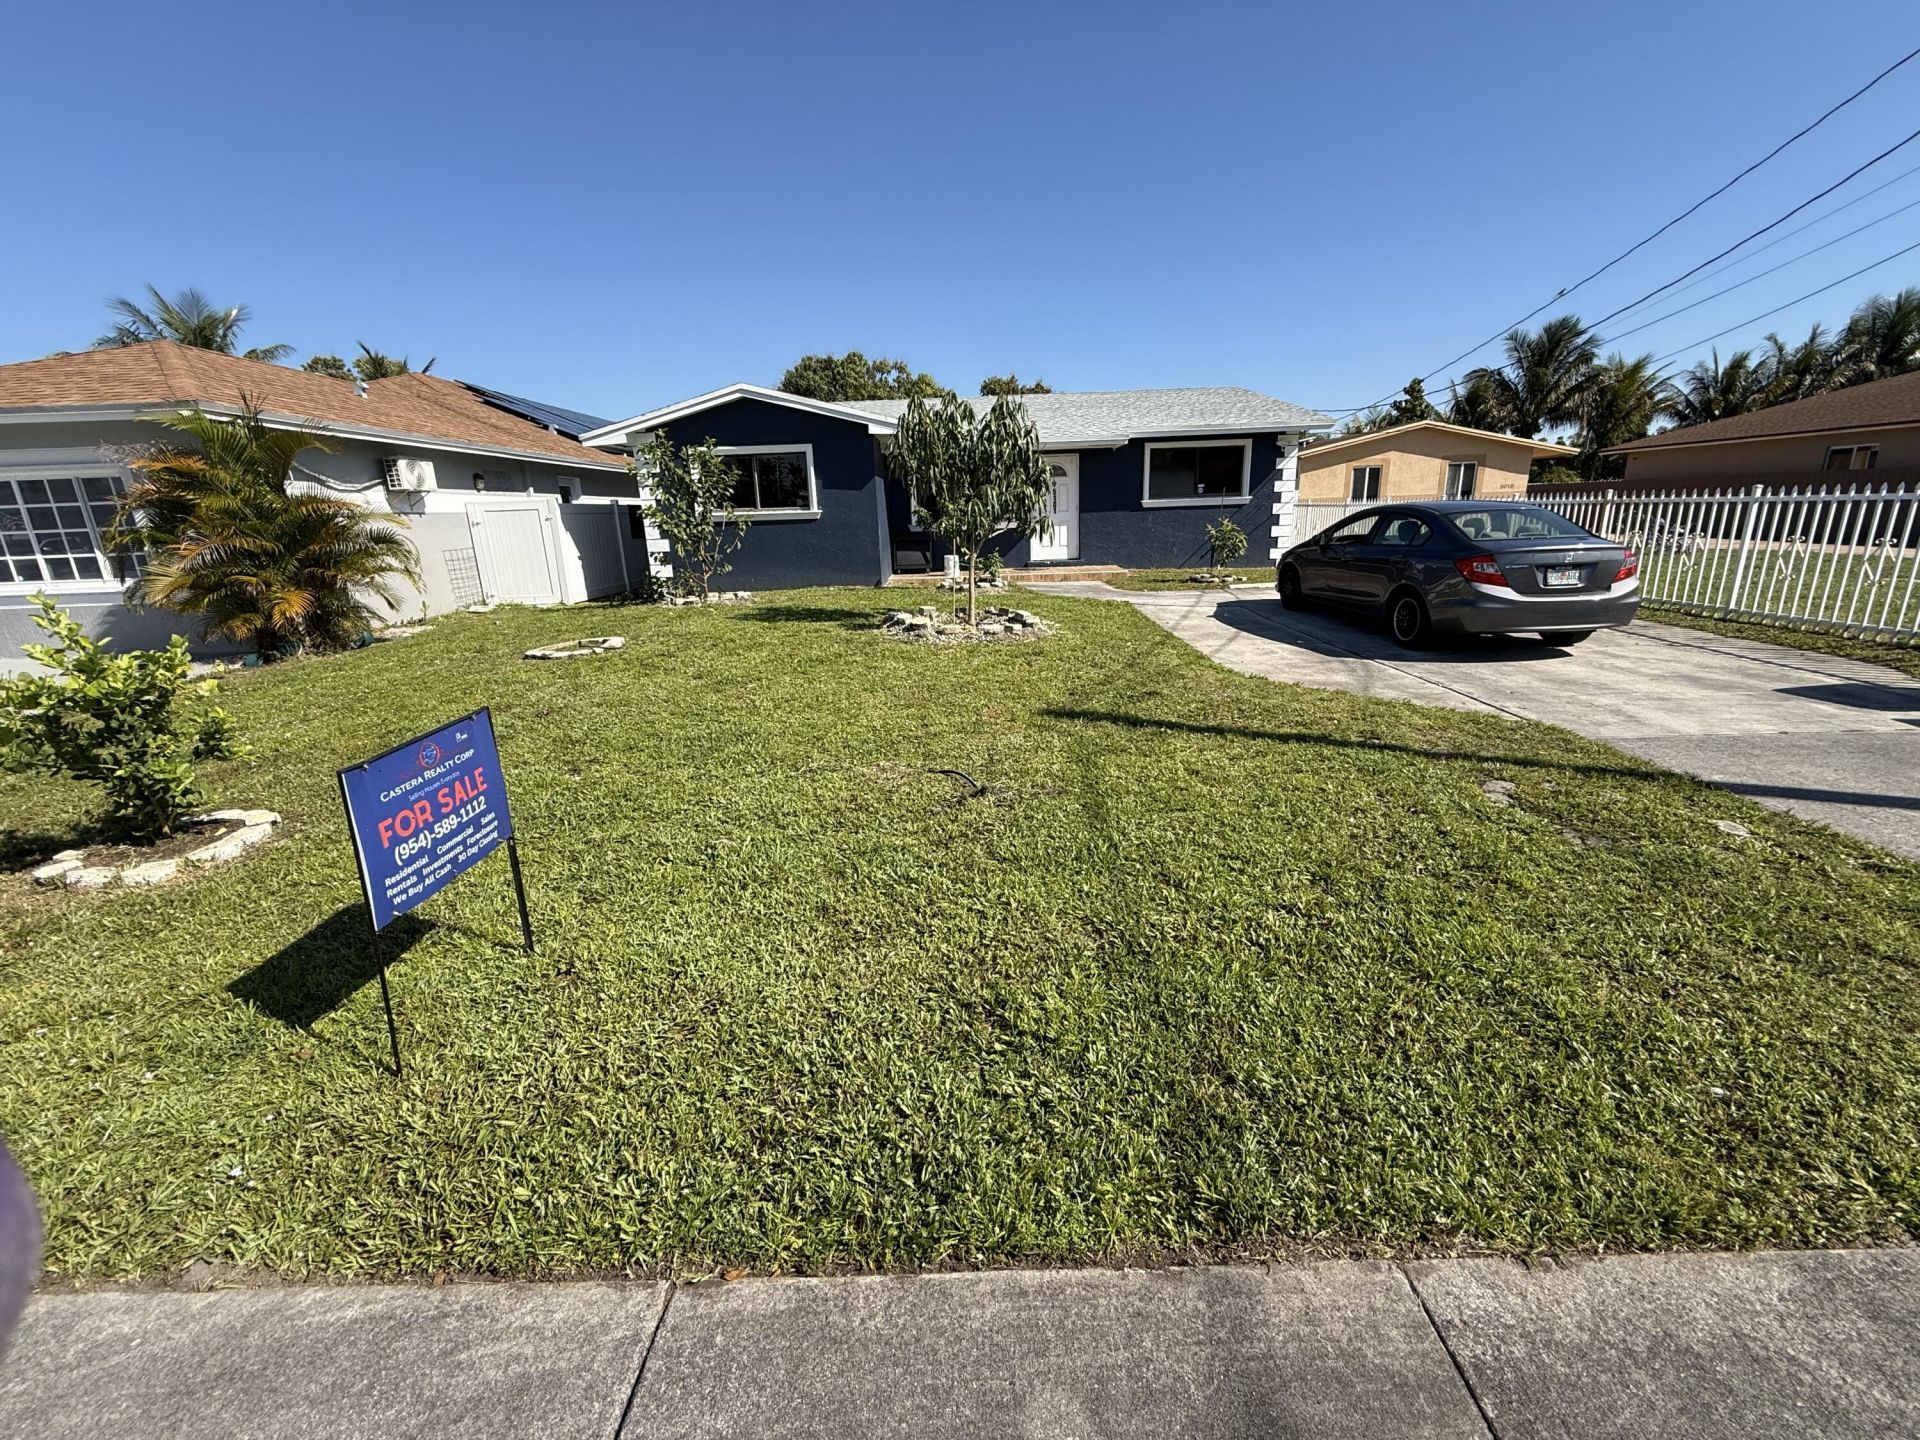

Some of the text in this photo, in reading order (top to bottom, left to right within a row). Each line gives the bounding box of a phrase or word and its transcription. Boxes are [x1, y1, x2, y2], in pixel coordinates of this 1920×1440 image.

[378, 767, 487, 849] FOR SALE
[381, 749, 474, 802] CASTERA REALTY CORP
[385, 812, 495, 887] Residential Commercial Sales
[387, 820, 498, 898] Rentals Investments Foreclosure
[393, 830, 498, 905] We Buy All Cash 30 Day Closing
[395, 796, 486, 866] (954)-589-1112
